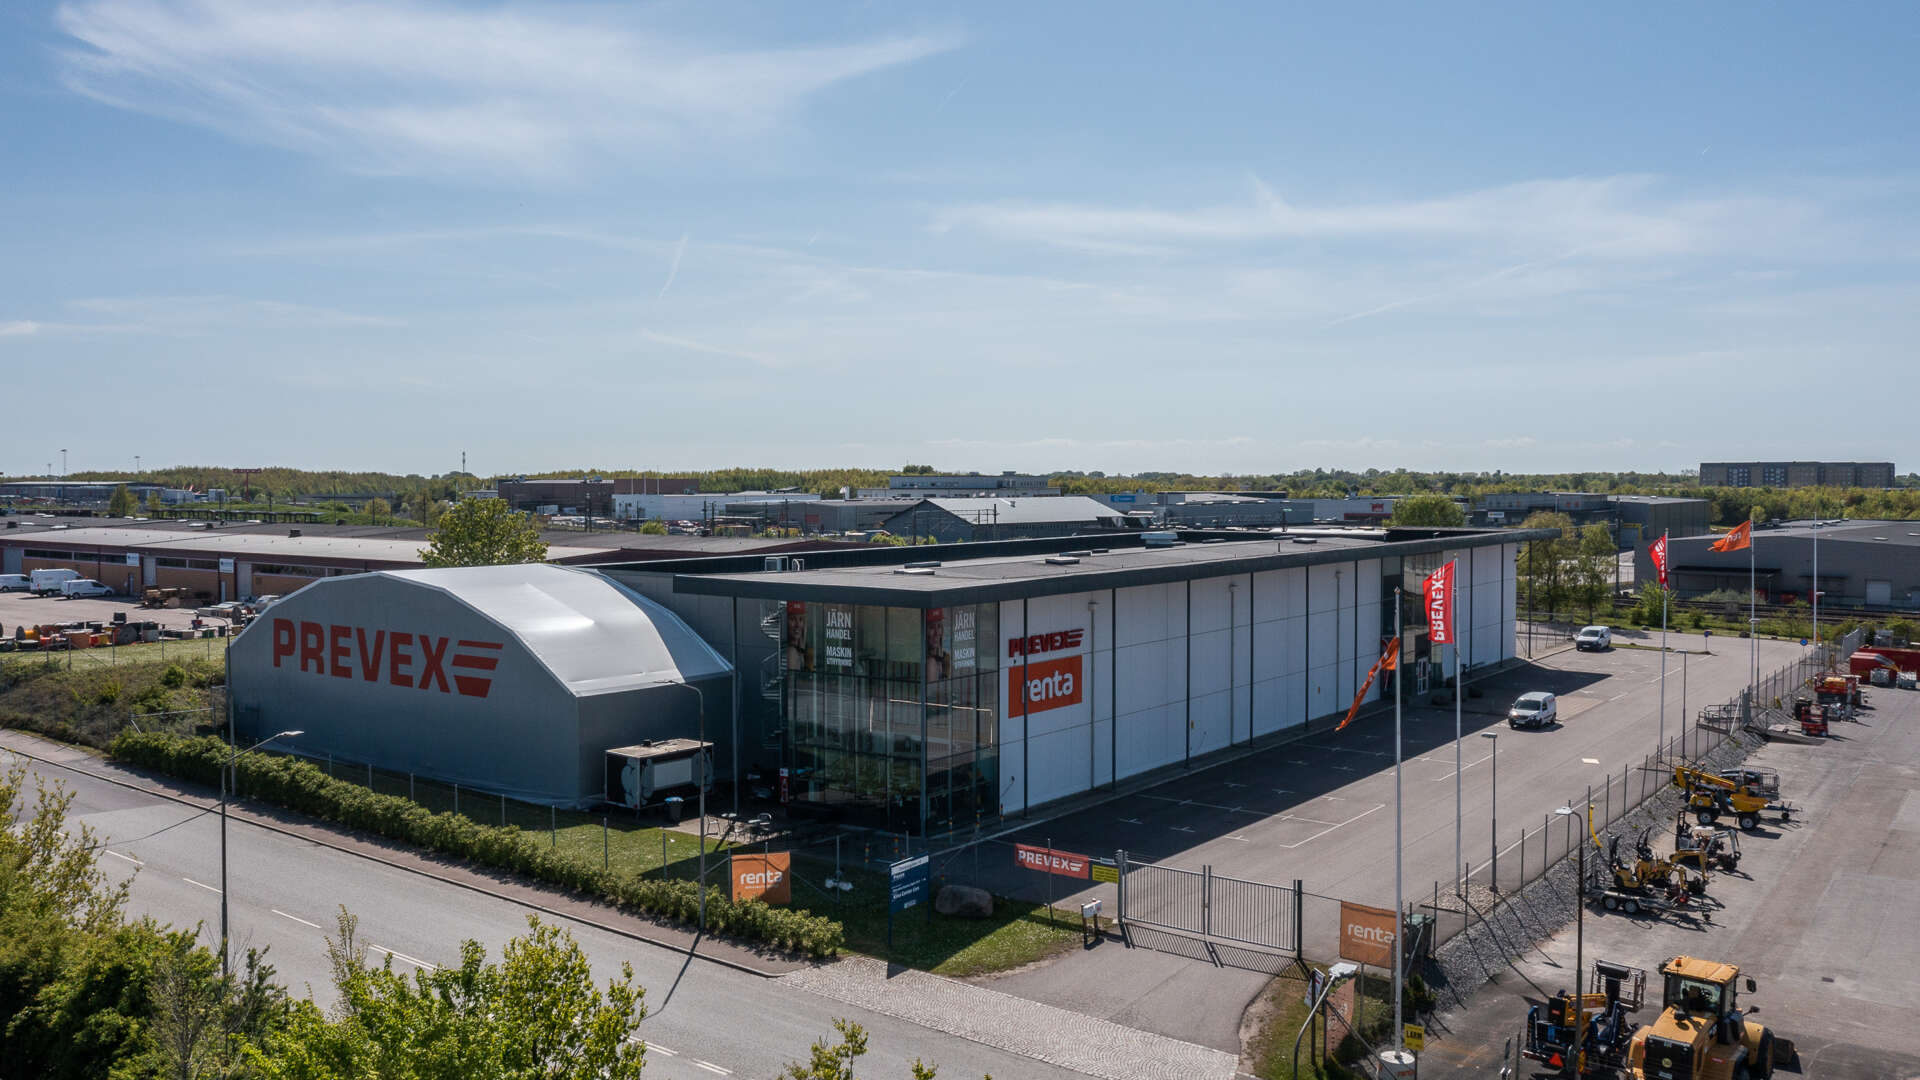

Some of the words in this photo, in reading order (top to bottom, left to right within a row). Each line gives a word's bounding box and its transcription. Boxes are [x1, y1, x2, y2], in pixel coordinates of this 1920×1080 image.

[826, 608, 852, 628] JÄRN
[954, 610, 975, 631] JÄRN
[826, 628, 852, 640] HANDEL
[954, 630, 975, 641] HANDEL
[273, 617, 451, 693] PREVEX
[826, 645, 852, 658] MASKIN
[954, 647, 975, 659] MASKIN
[1018, 850, 1072, 871] PREVEX
[740, 870, 783, 884] renta
[1347, 923, 1395, 944] renta
